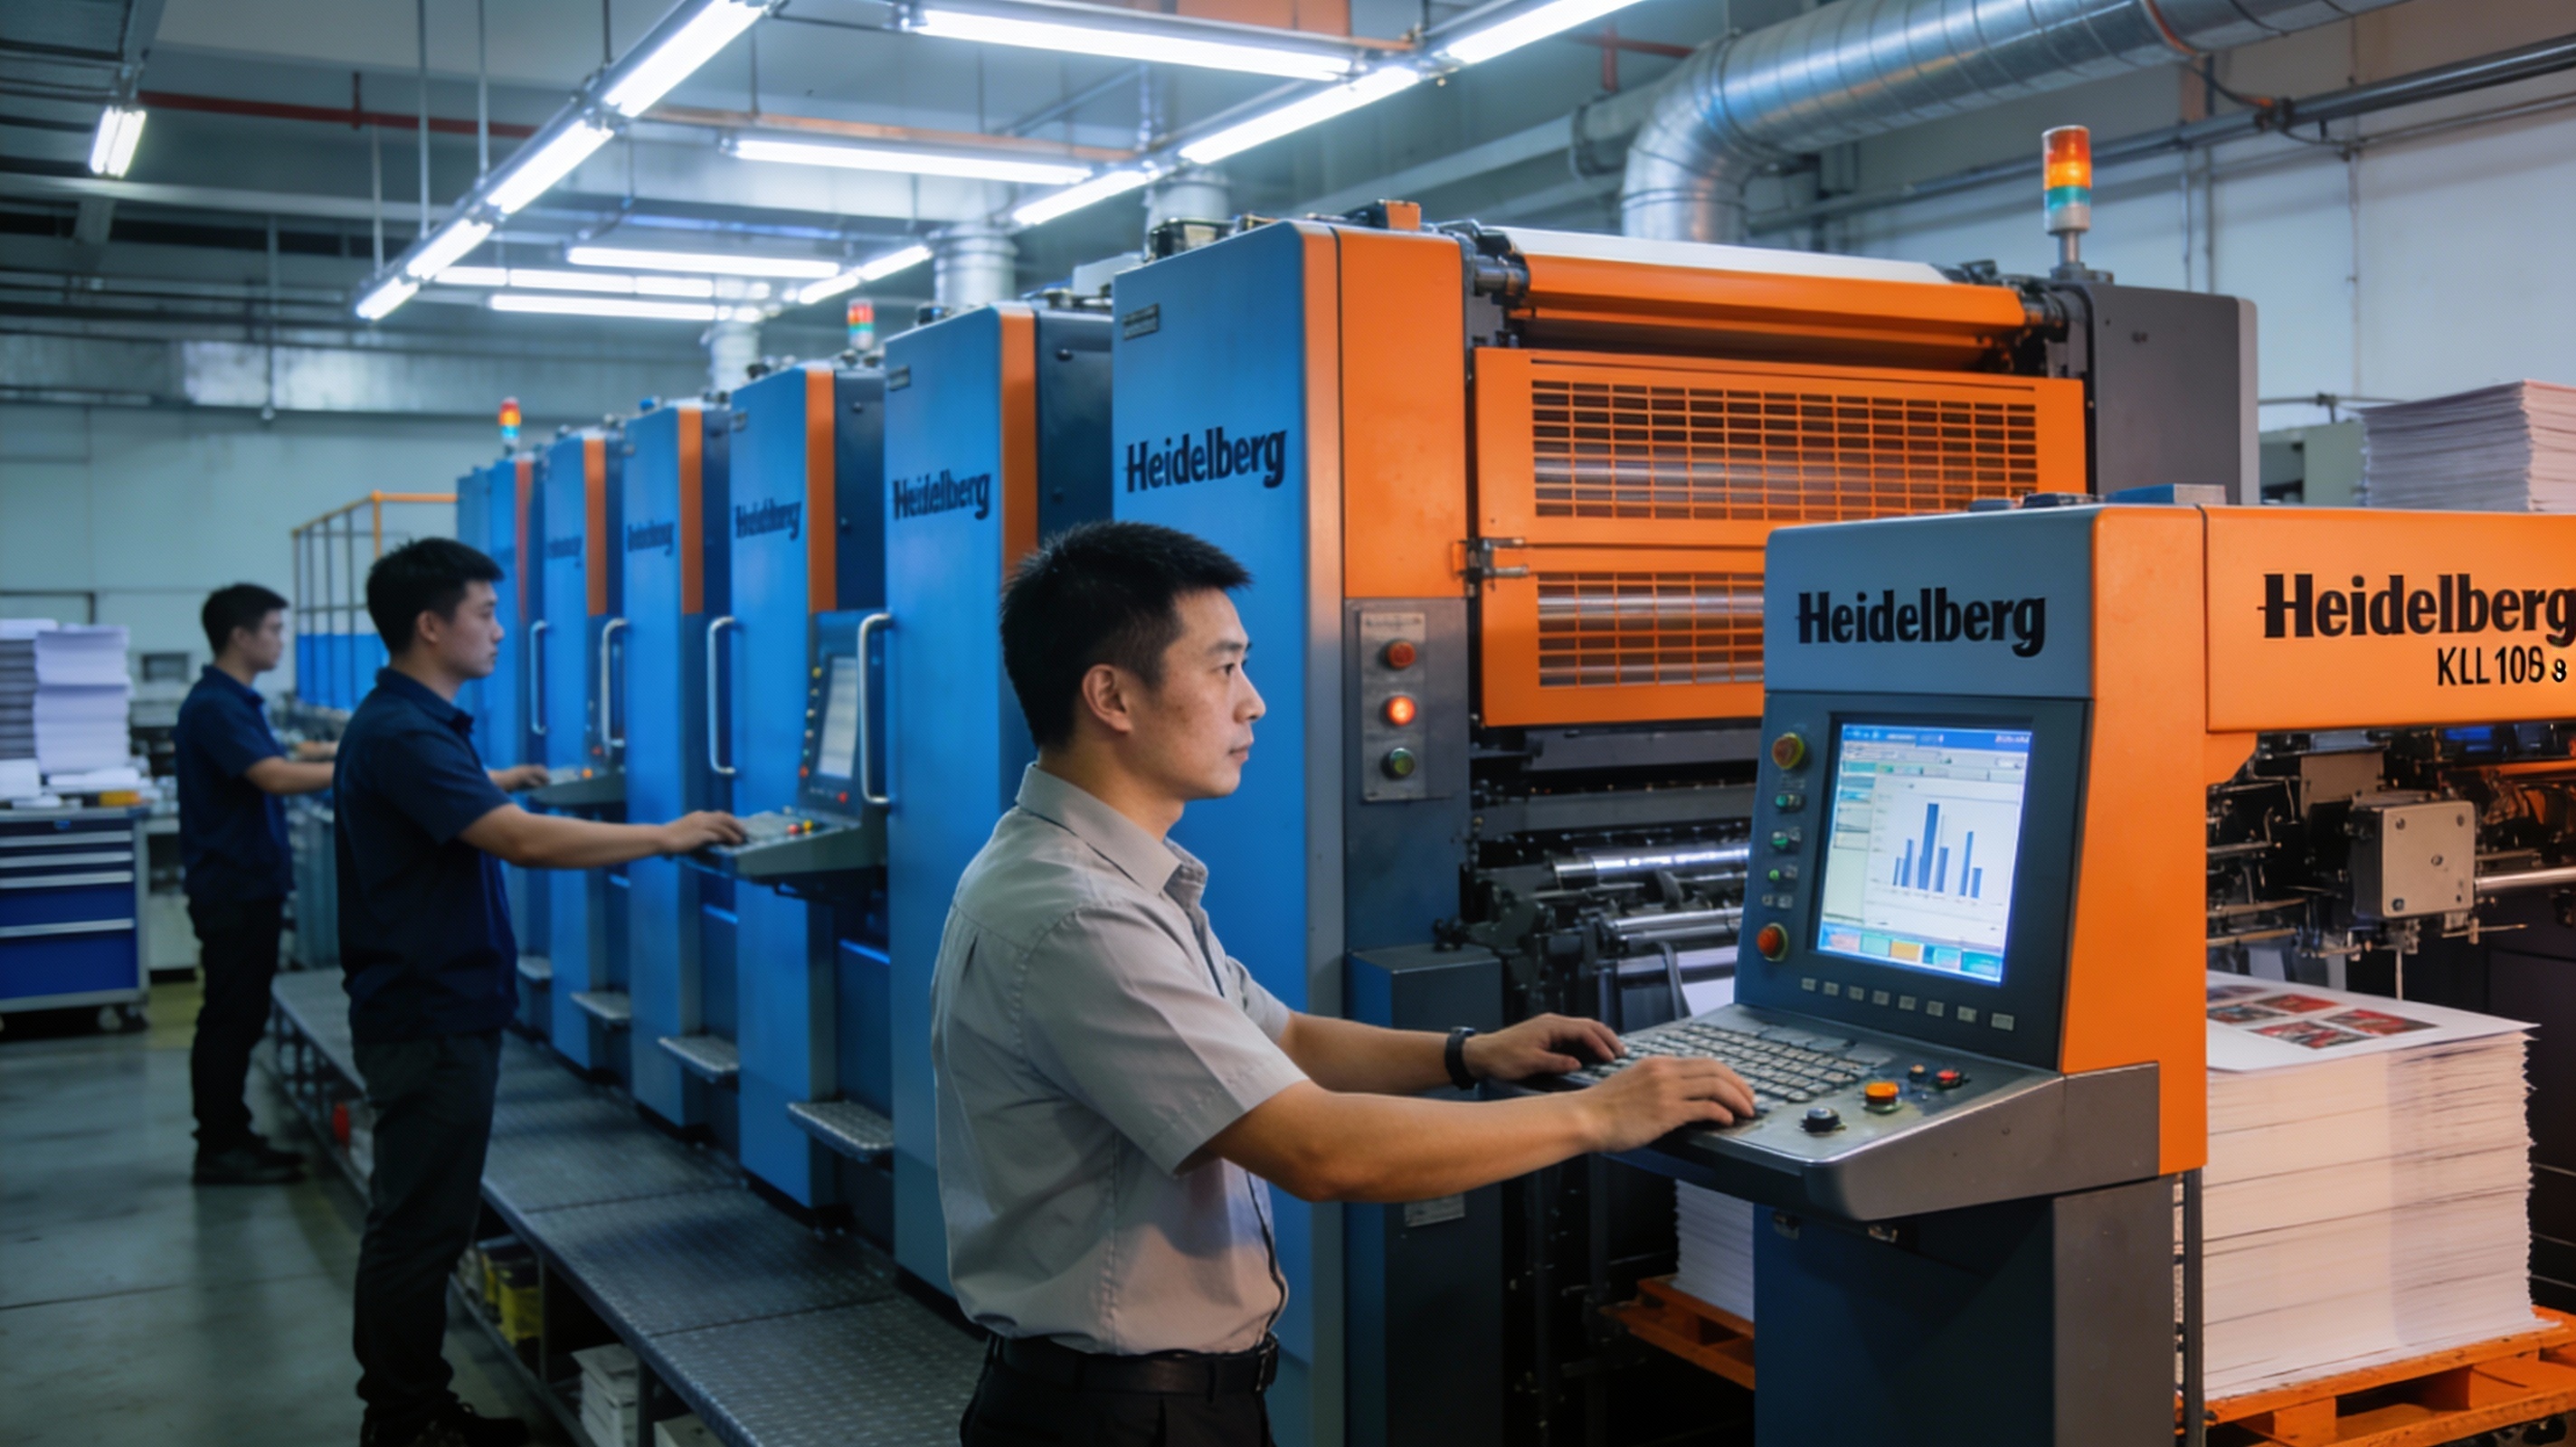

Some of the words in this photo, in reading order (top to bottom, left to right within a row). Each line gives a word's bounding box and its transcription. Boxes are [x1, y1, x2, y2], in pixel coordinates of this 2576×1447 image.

[1125, 426, 1287, 493] Heidelberg
[1797, 587, 2046, 657] Heidelberg
[2259, 573, 2576, 648] Heidelberg
